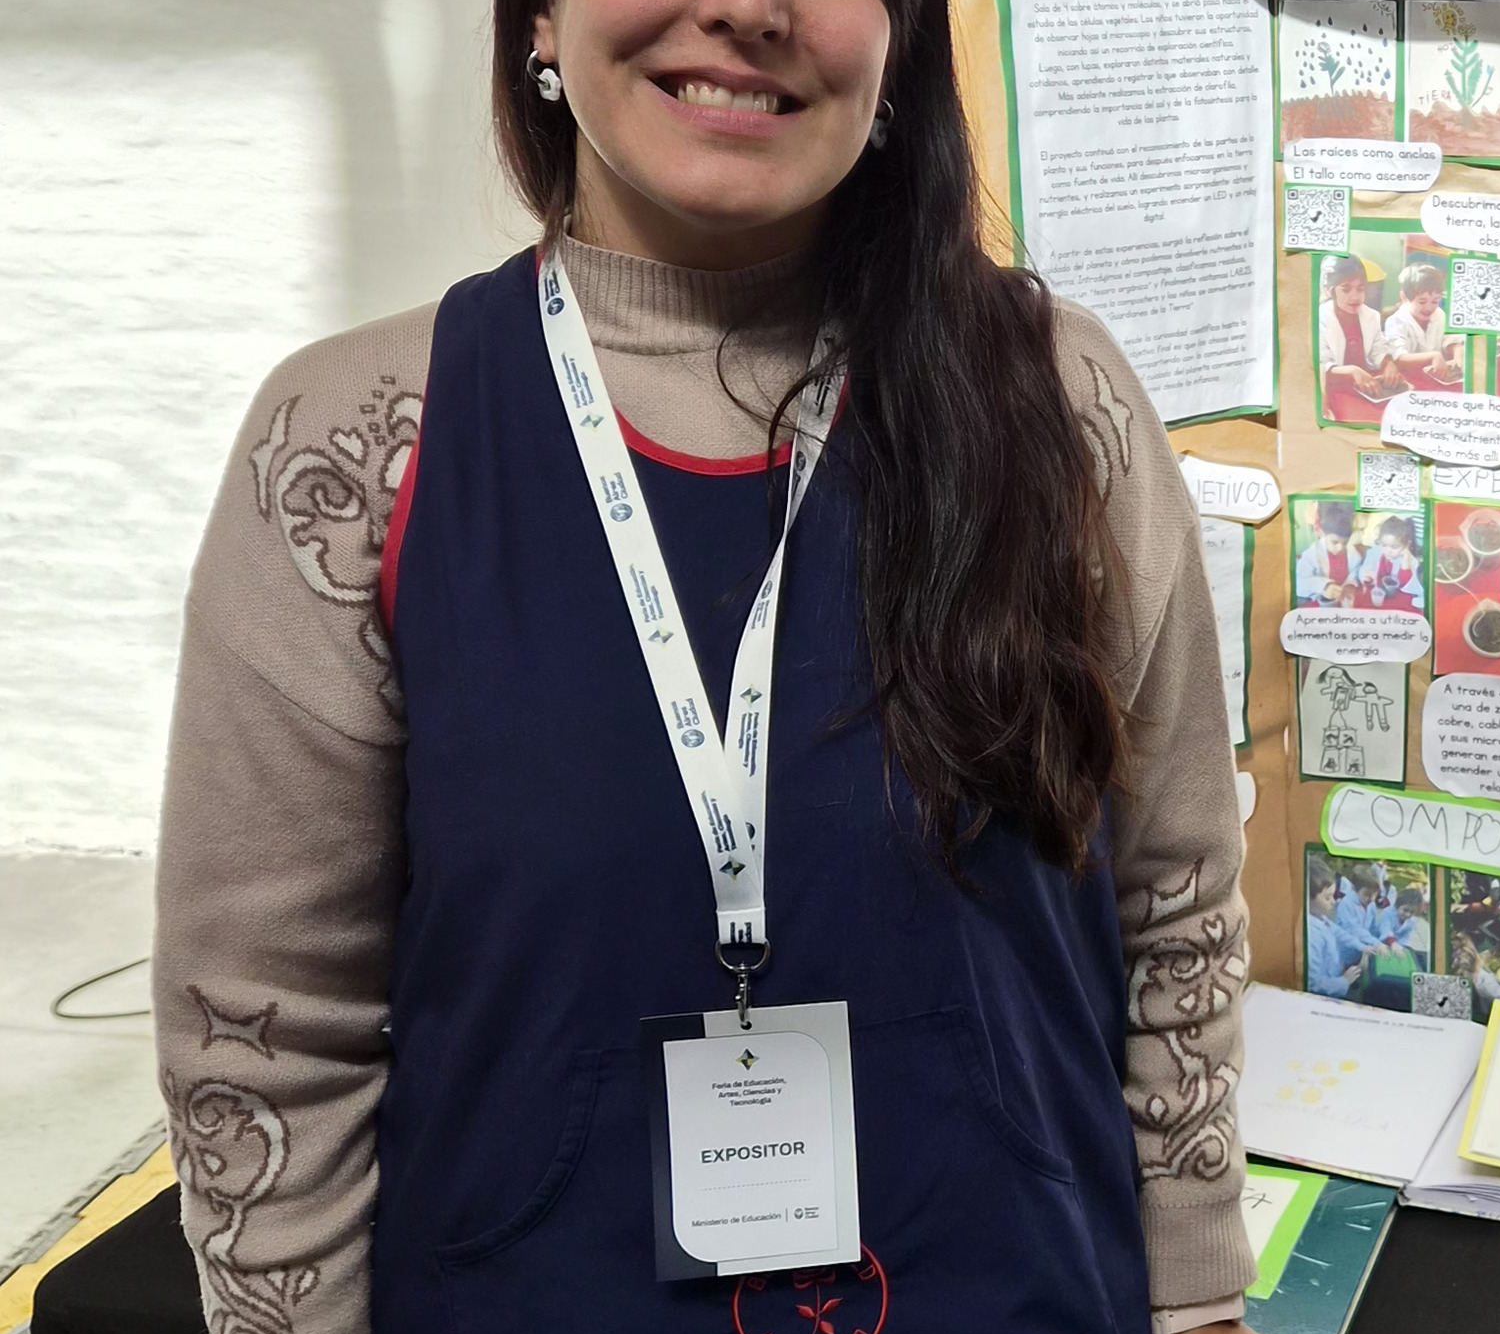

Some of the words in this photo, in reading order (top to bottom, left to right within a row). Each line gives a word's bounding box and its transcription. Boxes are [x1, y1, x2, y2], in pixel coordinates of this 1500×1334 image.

[712, 1082, 731, 1090] Feria
[743, 1078, 787, 1087] Educación,
[718, 1091, 741, 1099] Artes,
[743, 1088, 776, 1096] Ciencias
[729, 1097, 772, 1107] Tecnología
[701, 1141, 805, 1164] EXPOSITOR
[691, 1218, 729, 1227] Ministerio
[741, 1213, 782, 1223] Educación
